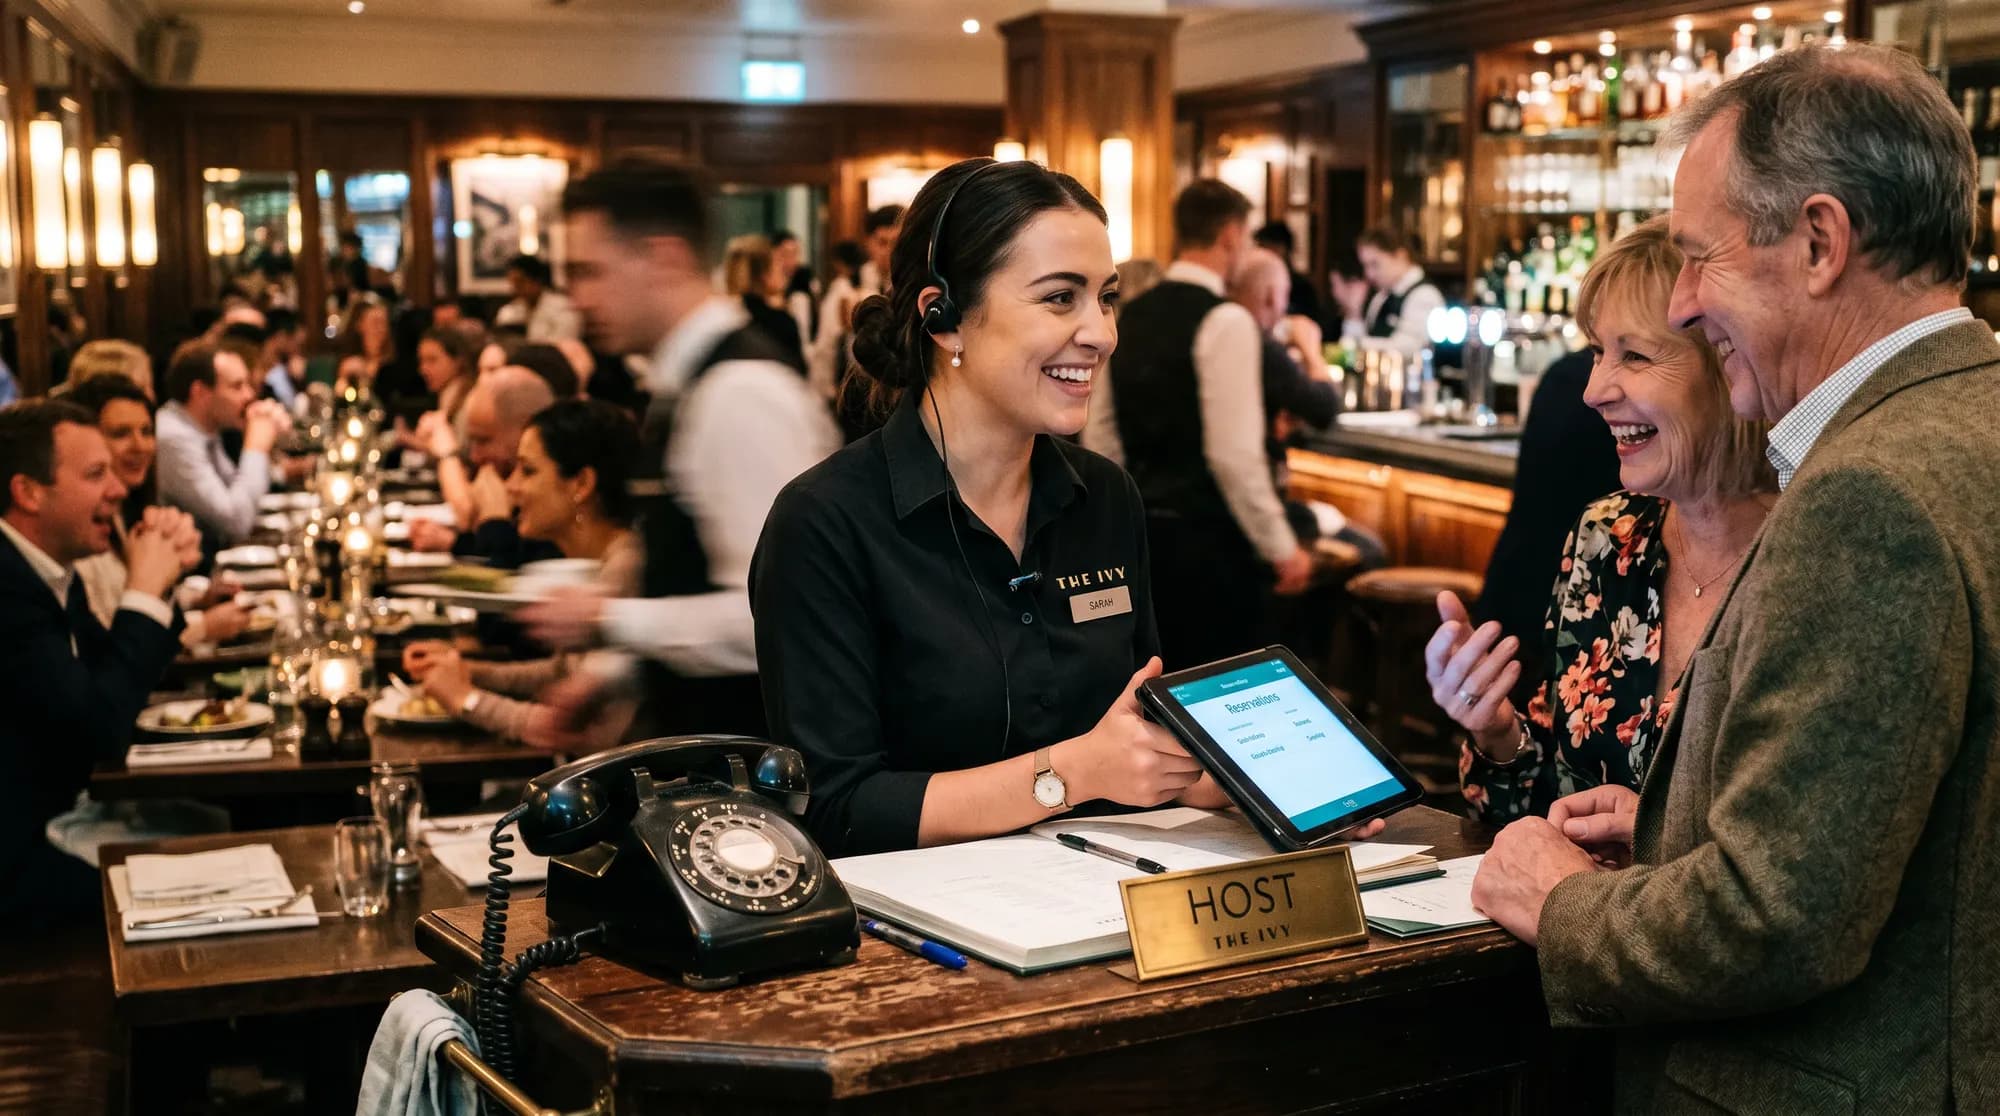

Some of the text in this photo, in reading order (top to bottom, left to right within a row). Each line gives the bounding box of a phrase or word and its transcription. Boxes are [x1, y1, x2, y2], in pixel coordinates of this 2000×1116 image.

[1056, 566, 1126, 590] THE IVY
[1089, 598, 1114, 611] SARAH
[1224, 692, 1281, 715] Reservations
[1187, 872, 1295, 925] HOST
[1213, 924, 1290, 950] THE IVY
